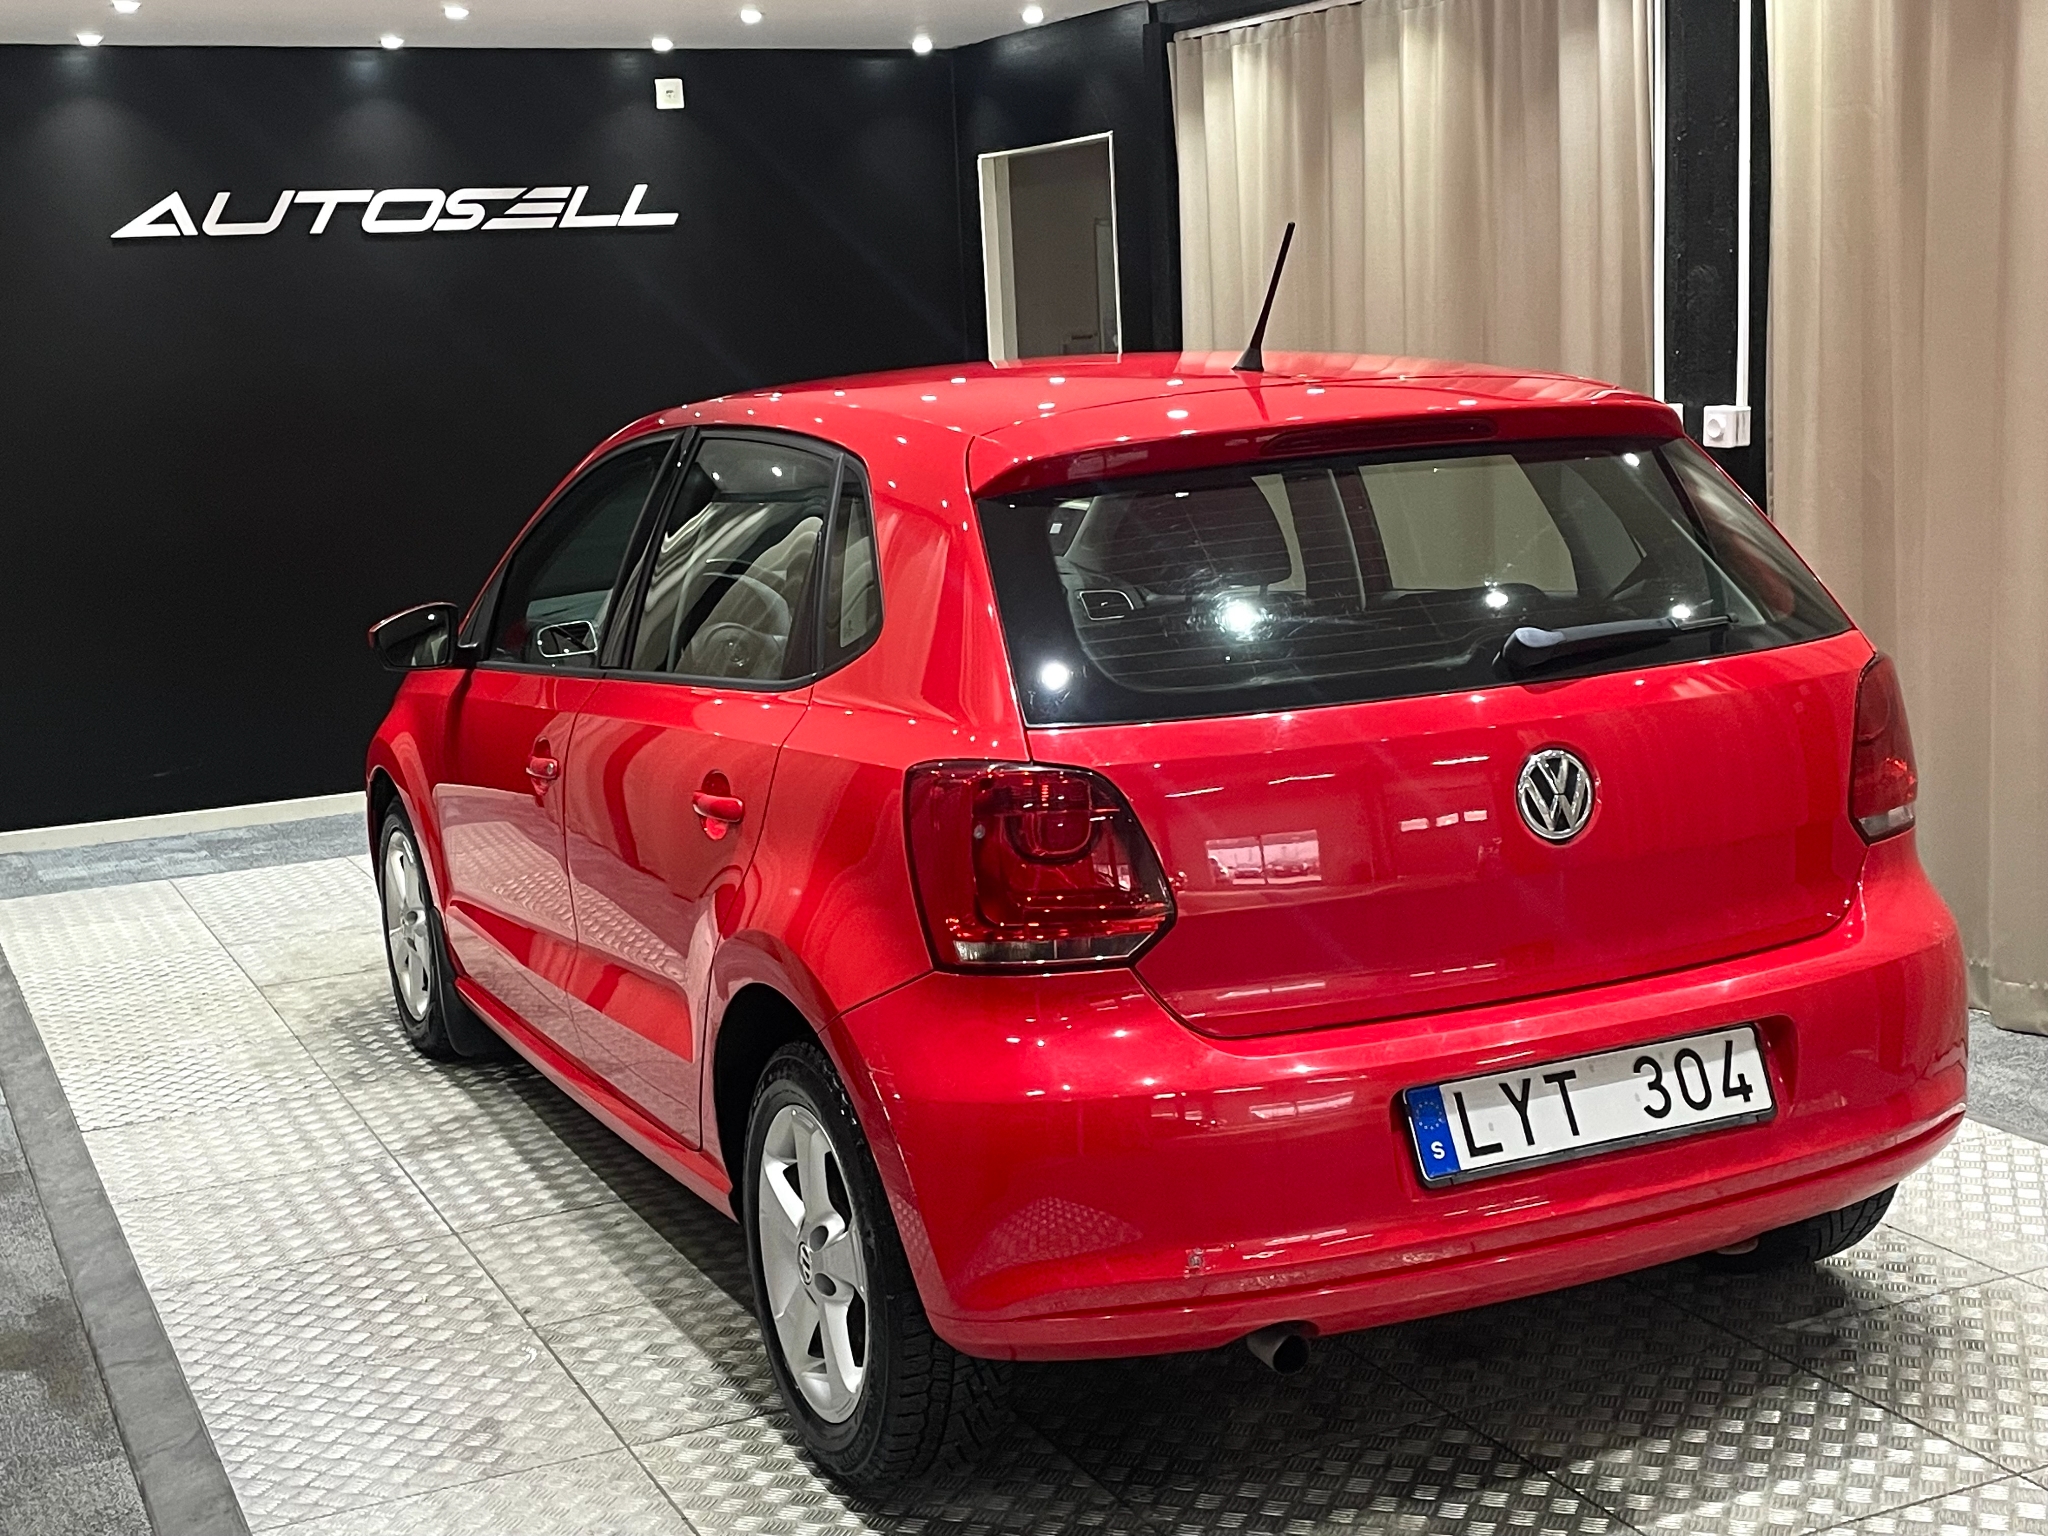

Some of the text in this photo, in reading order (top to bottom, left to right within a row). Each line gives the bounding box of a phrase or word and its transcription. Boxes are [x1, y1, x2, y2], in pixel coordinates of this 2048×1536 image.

[110, 183, 679, 238] AUTOSELL
[1453, 1040, 1754, 1158] LYT 304
[1430, 1140, 1446, 1160] S
